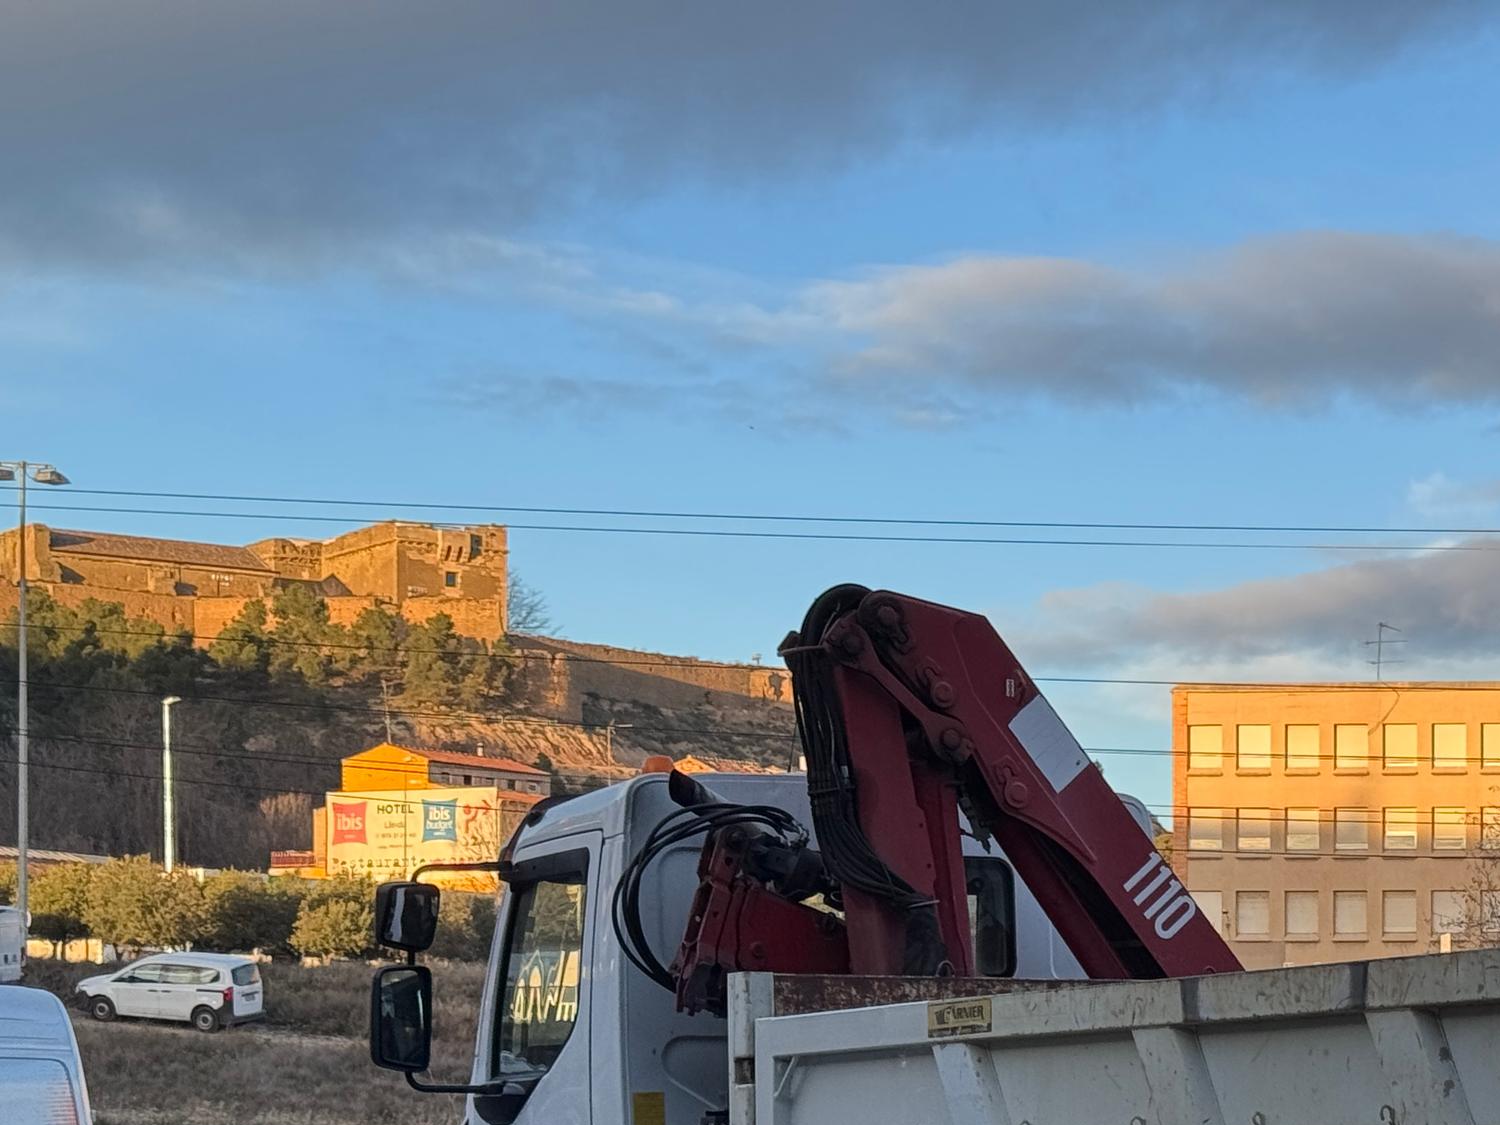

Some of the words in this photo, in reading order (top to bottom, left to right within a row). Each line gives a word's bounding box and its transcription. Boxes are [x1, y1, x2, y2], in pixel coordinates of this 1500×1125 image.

[377, 804, 414, 814] HOTEL
[428, 806, 451, 821] ibis
[336, 813, 363, 831] ibis
[426, 820, 454, 832] budget
[1123, 851, 1197, 940] 1110
